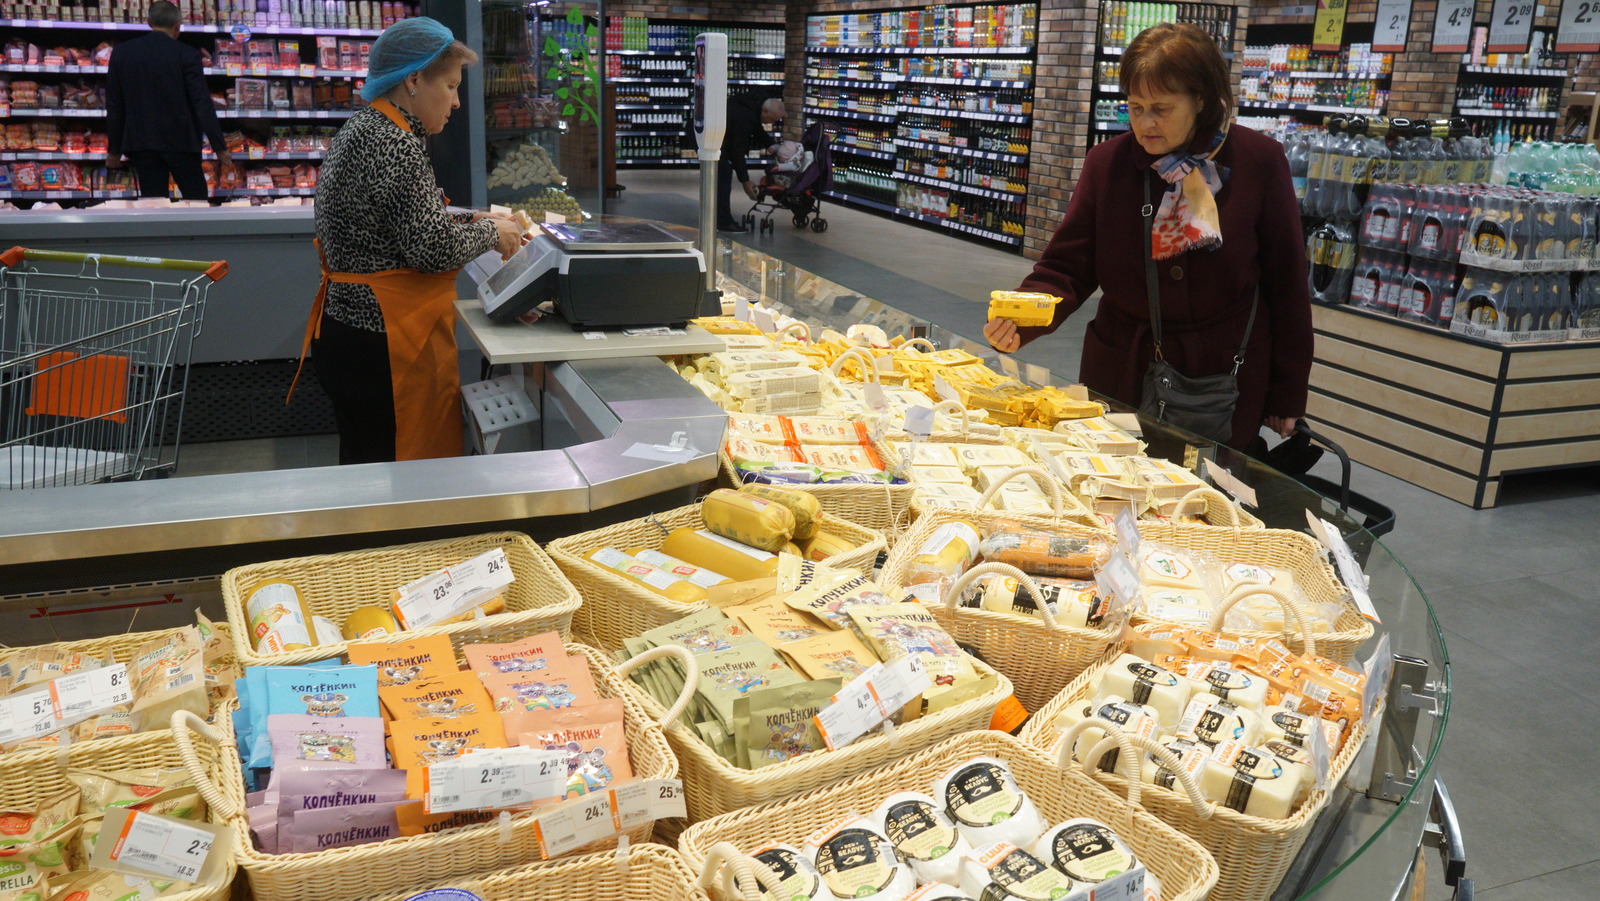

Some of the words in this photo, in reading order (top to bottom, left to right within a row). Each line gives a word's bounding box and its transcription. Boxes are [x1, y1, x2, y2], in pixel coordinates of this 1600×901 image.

[1448, 7, 1472, 27] 4.29
[1504, 5, 1532, 26] 2.09
[1522, 260, 1543, 270] Kozel
[1587, 259, 1600, 268] Koz
[1464, 325, 1486, 336] Kozel
[1511, 331, 1531, 341] Kozel
[433, 580, 453, 601] 23.06
[267, 635, 280, 653] ГИПП
[701, 660, 758, 678] КОПЧЁНКИН
[111, 671, 128, 686] 8.27
[766, 706, 820, 727] КОПЧЁНКИН
[1219, 741, 1237, 763] ГИППО
[481, 768, 500, 784] 2.39
[303, 792, 376, 810] КОПЧЁНКИН
[317, 825, 390, 848] КОПЧЁНКИН
[0, 863, 22, 873] esto
[0, 875, 34, 890] RELLA
